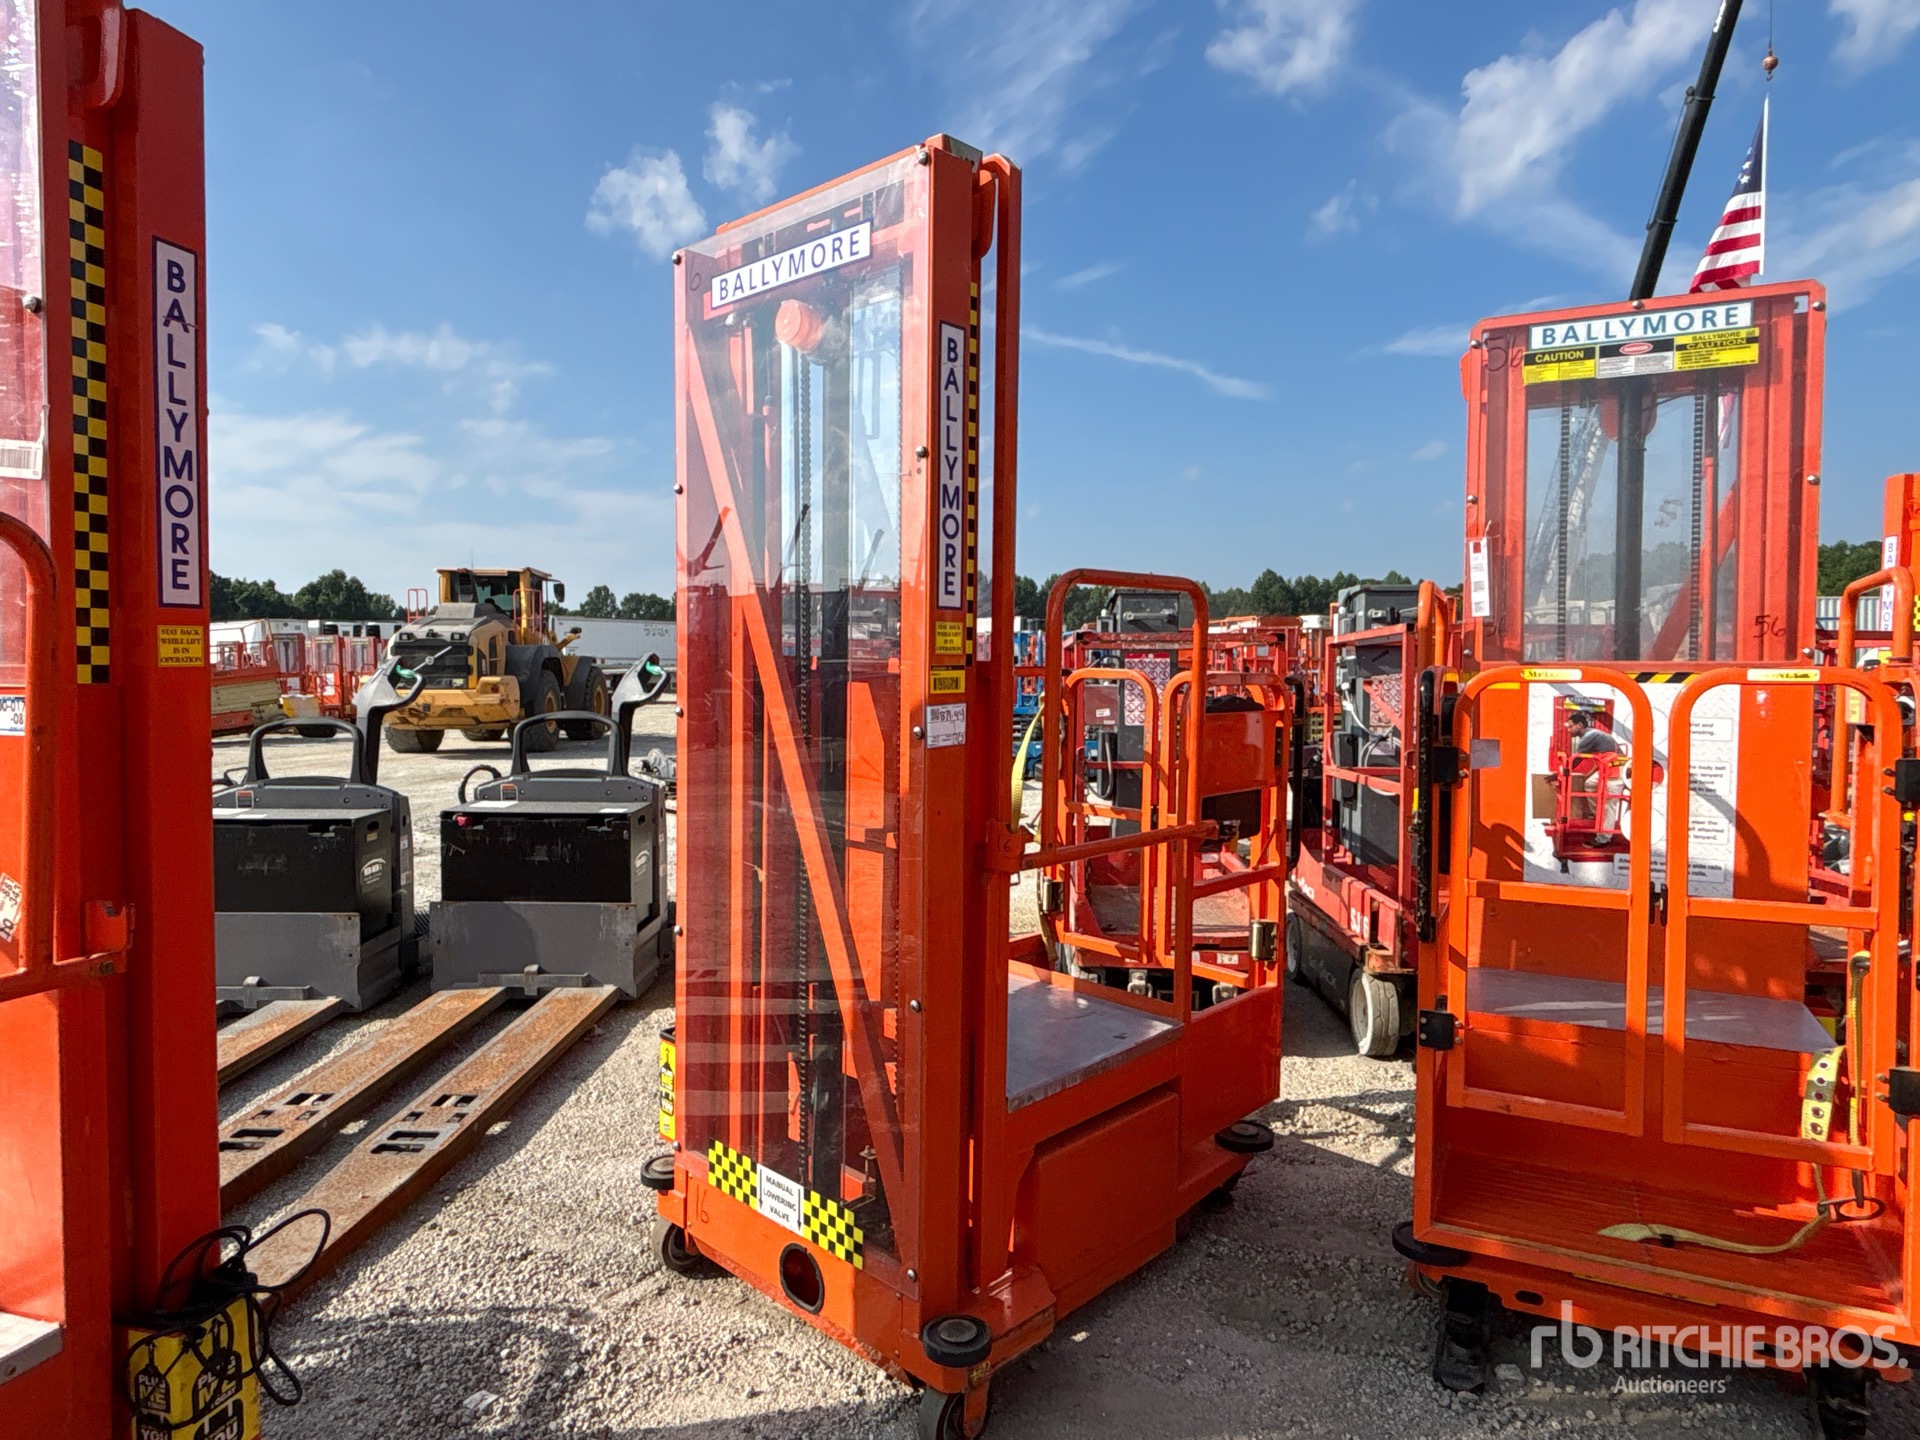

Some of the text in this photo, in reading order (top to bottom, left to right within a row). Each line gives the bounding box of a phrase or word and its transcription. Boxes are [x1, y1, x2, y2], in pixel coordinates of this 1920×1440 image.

[719, 229, 861, 301] BALLYMORE
[1542, 306, 1739, 346] BALLYMORE
[1691, 331, 1741, 342] BALLYMORE
[1686, 338, 1747, 350] CAUTION
[1535, 350, 1585, 363] CAUTION
[157, 259, 194, 590] BALLYMORE
[942, 336, 960, 597] BALLYMORE
[161, 628, 178, 636] STAY
[1753, 614, 1787, 638] 56
[160, 656, 202, 664] OPERATION
[765, 1175, 794, 1197] MANUAL
[695, 1183, 710, 1224] 16
[763, 1187, 797, 1212] LOWERING
[769, 1205, 790, 1223] VALVE
